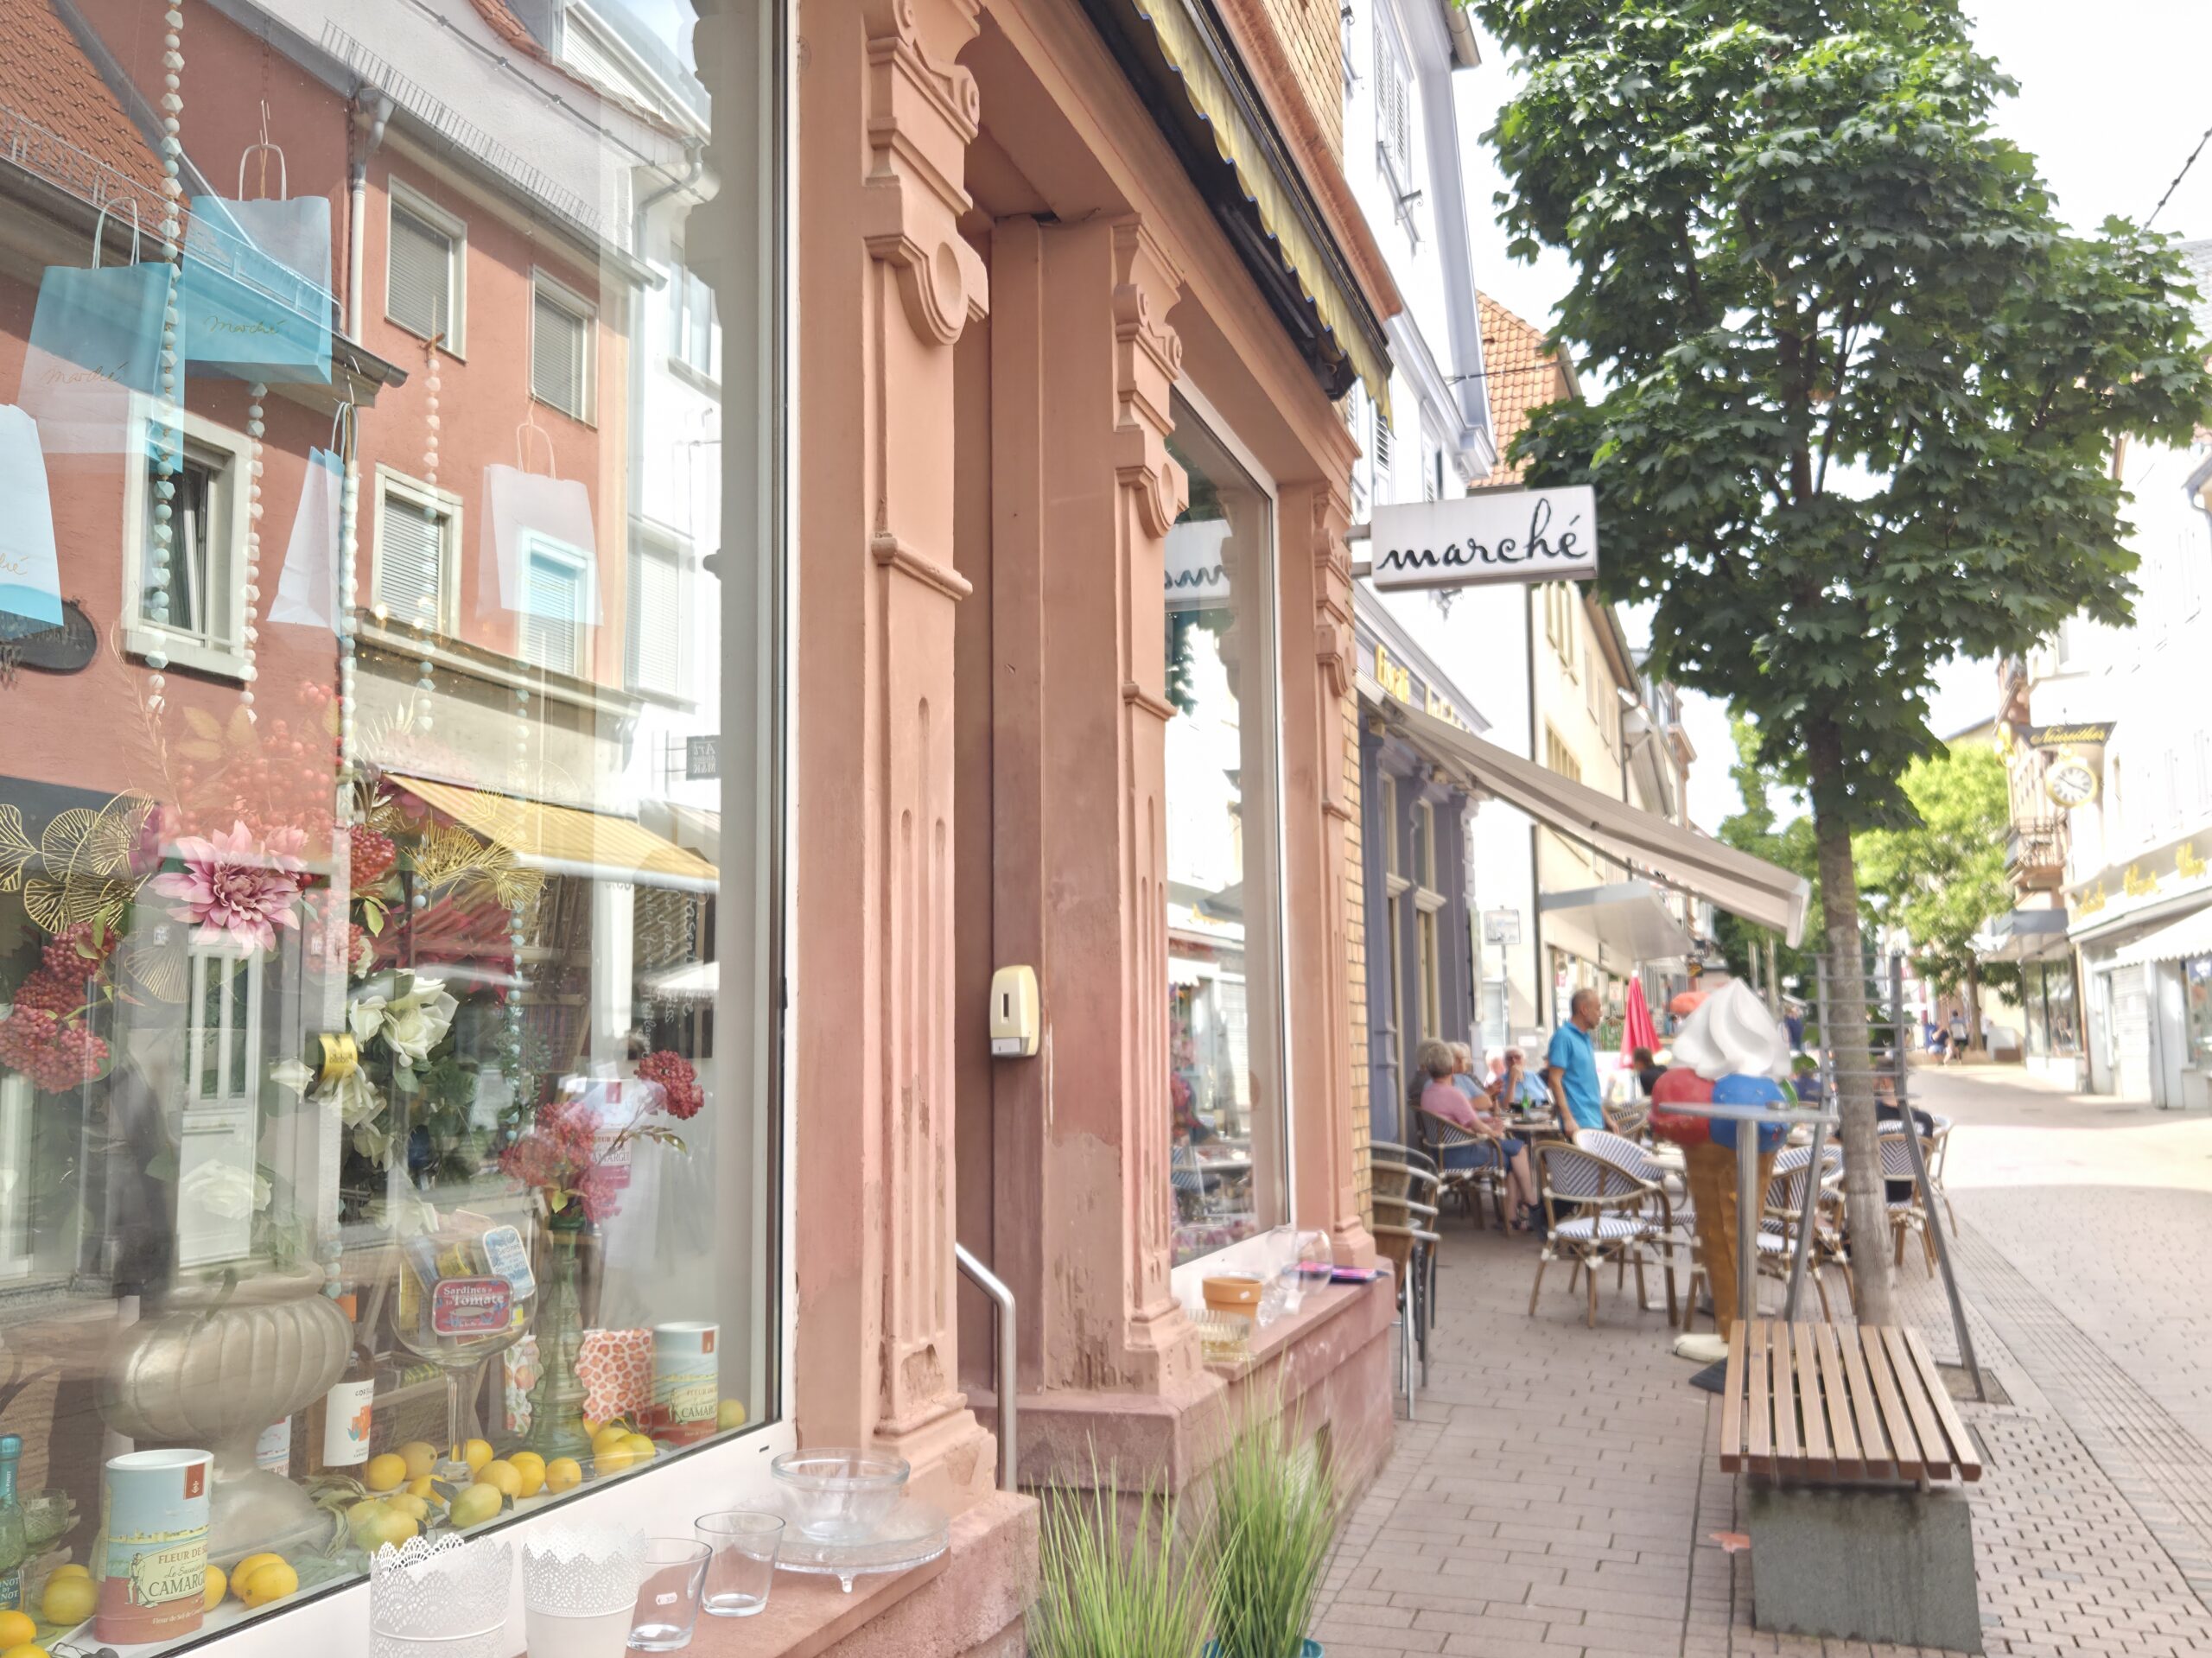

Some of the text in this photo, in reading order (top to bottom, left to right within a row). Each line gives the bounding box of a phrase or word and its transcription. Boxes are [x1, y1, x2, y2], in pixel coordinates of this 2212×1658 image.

[1376, 497, 1588, 571] marché
[658, 915, 677, 963] jeden
[443, 1284, 486, 1296] Sardines
[451, 1293, 505, 1307] Tomate
[158, 1551, 189, 1565] FLEUR
[192, 1547, 201, 1558] DE
